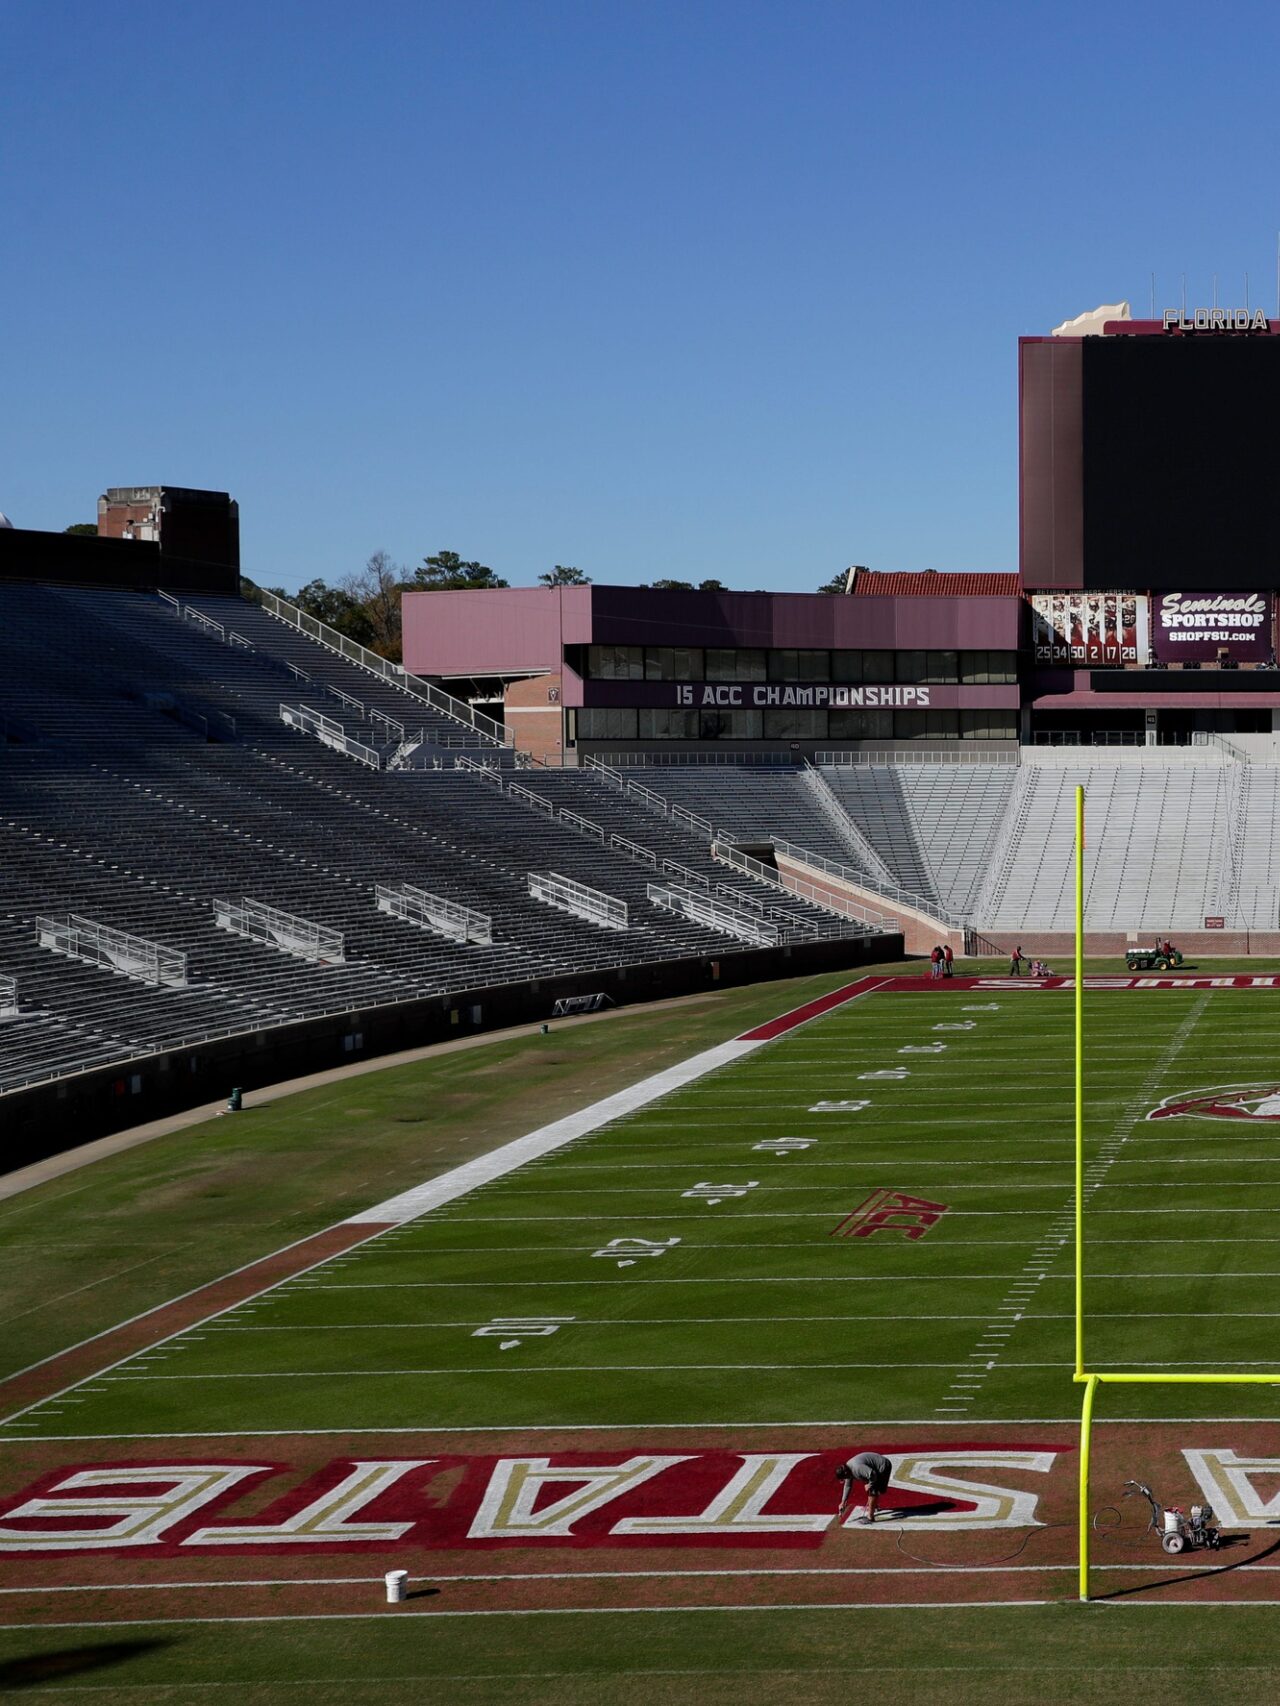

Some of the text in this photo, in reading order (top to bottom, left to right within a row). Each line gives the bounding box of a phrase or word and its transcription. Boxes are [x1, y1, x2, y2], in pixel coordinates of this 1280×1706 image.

[1162, 308, 1267, 330] FLORIDA
[1160, 592, 1266, 616] Seminole
[1161, 613, 1265, 628] SPORTSHOP
[1168, 631, 1256, 642] SHOPFSU.COM
[1037, 646, 1051, 659] 25
[1053, 646, 1067, 659] 34
[1070, 646, 1085, 659] 50
[1090, 646, 1099, 659] 2
[1106, 646, 1117, 659] 17
[1122, 646, 1136, 659] 28
[676, 685, 930, 706] 15 ACC CHAMPIONSHIPS
[680, 1181, 760, 1198] 30
[590, 1237, 682, 1258] 20
[470, 1316, 576, 1338] 10
[0, 1450, 1058, 1550] STATE
